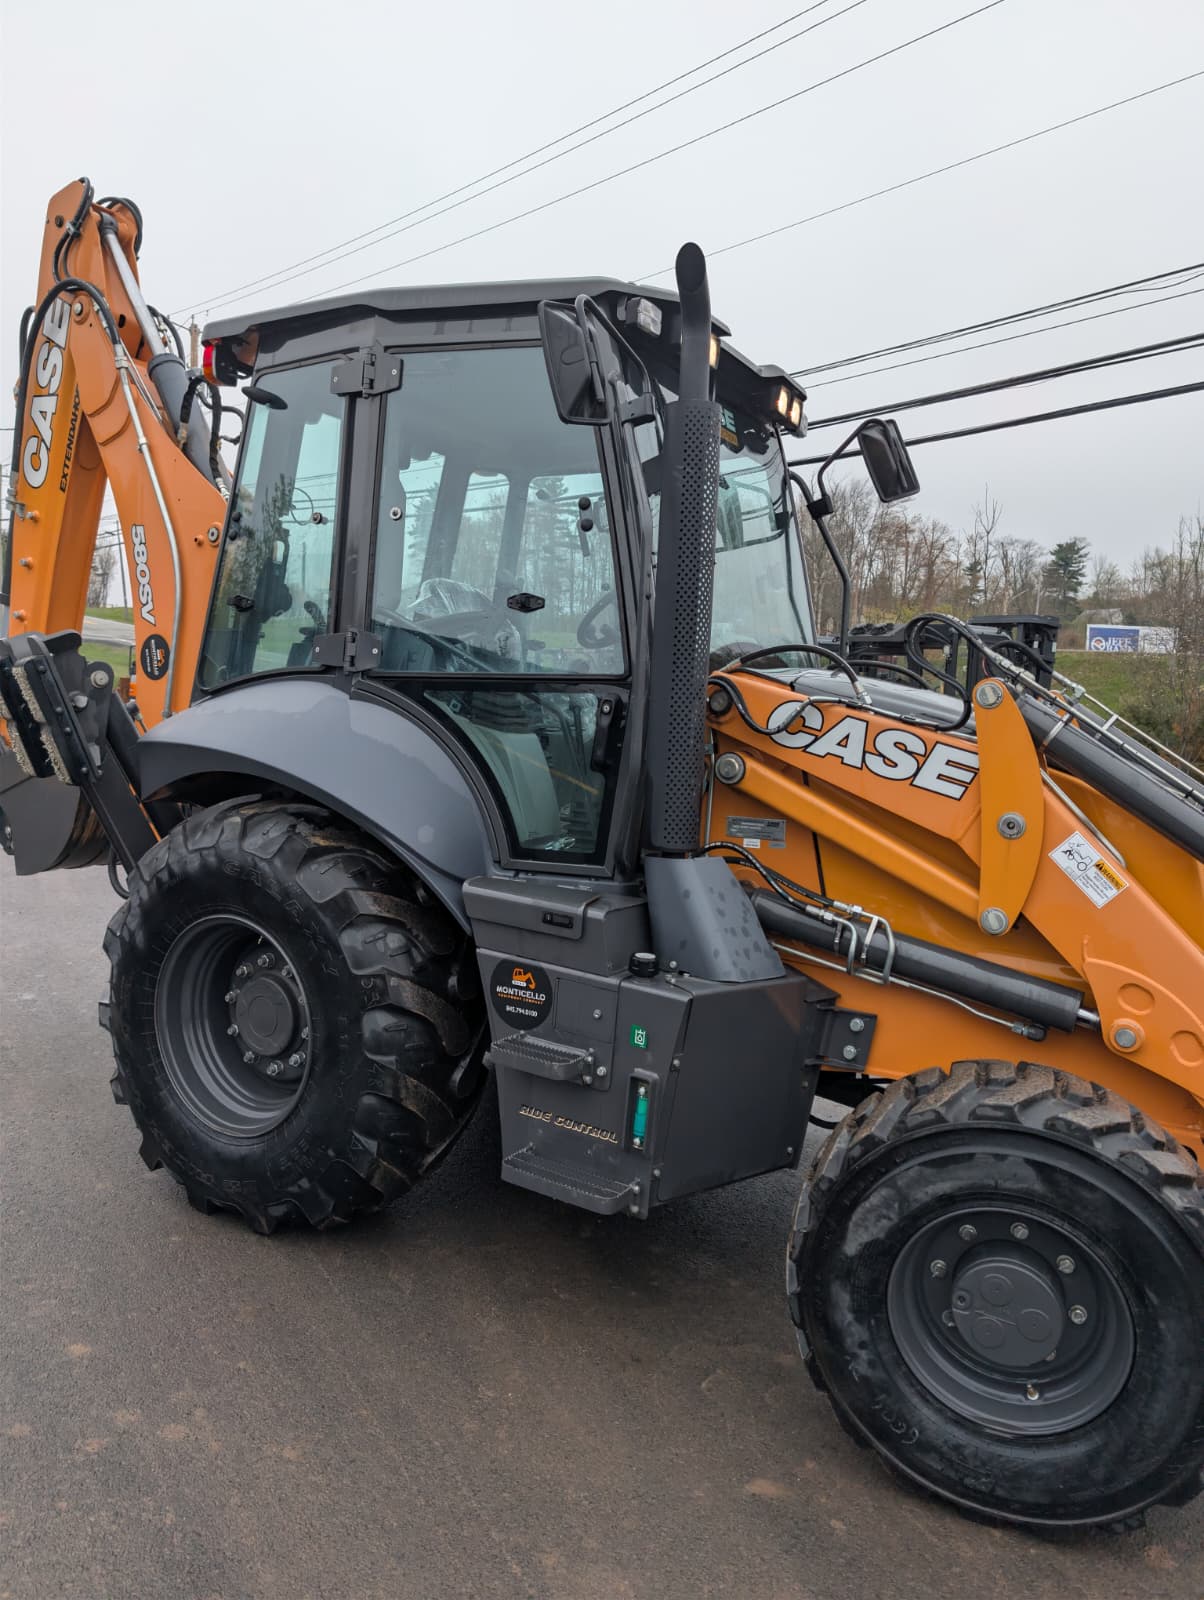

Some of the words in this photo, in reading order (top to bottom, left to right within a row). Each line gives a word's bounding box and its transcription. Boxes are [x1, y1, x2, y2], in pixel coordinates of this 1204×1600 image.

[23, 298, 72, 488] CASE
[60, 385, 80, 493] EXTENDAHO
[131, 524, 157, 626] 580SV
[766, 700, 981, 801] CASE
[496, 985, 546, 1001] MONTICELLO
[519, 1103, 553, 1123] RIDE
[554, 1115, 619, 1144] CONTROL
